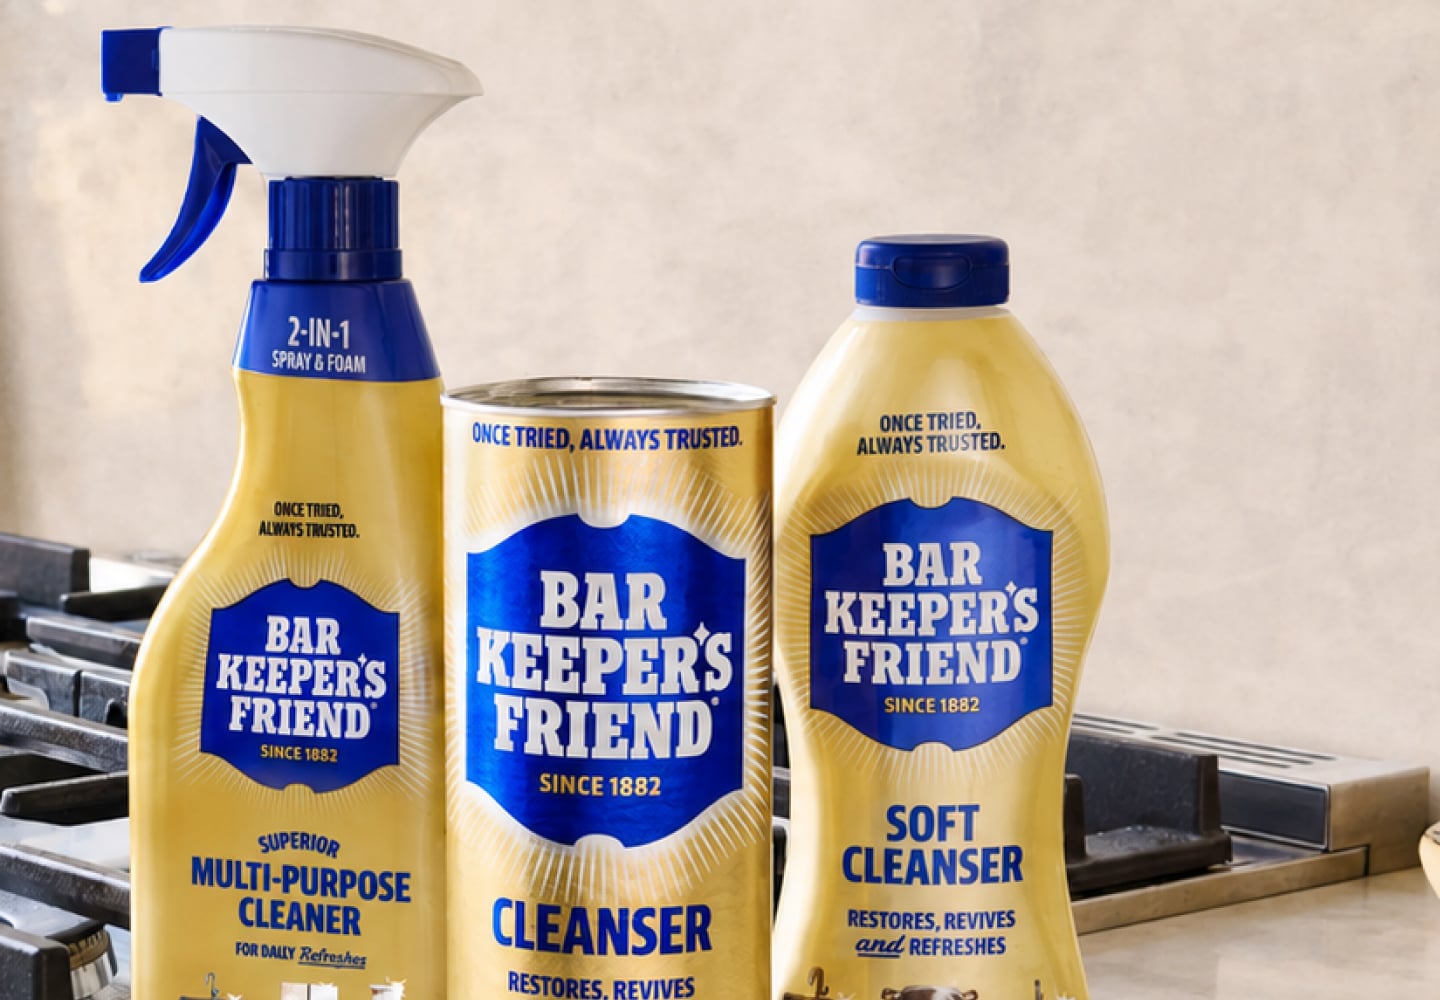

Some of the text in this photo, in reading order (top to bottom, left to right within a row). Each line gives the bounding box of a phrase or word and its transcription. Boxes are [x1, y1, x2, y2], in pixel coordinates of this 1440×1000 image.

[288, 315, 349, 349] 2-IN-1
[272, 349, 366, 373] SPRAY & FOAM
[470, 421, 743, 453] ONCE TRIED, ALWAYS TRUSTED.
[880, 413, 923, 432] ONCE
[856, 432, 1006, 456] ALWAYS TRUSTED.
[273, 501, 344, 519] ONCE TRIED,
[258, 520, 360, 538] ALWAYS TRUSTED.
[882, 541, 983, 587] BAR
[539, 570, 668, 631] BAR
[824, 580, 1039, 637] KEEPER'S
[264, 615, 341, 655] BAR
[476, 621, 733, 696] KEEPER'S
[215, 652, 388, 699] KEEPER'S
[884, 696, 981, 714] SINCE 1882
[260, 743, 339, 763] SINCE 1882
[539, 772, 661, 797] SINCE 1882
[886, 804, 981, 842] SOFT
[257, 831, 340, 858] SUPERIOR
[191, 856, 411, 903] MULTI-PURPOSE
[842, 845, 1023, 885] CLEANSER
[238, 896, 361, 936] CLEANER
[492, 897, 713, 957] CLEANSER
[848, 909, 1017, 932] RESTORES, REVIVES
[235, 940, 259, 957] FOR
[855, 934, 1007, 957] and REFRESHES
[613, 976, 696, 1000] REVIVES
